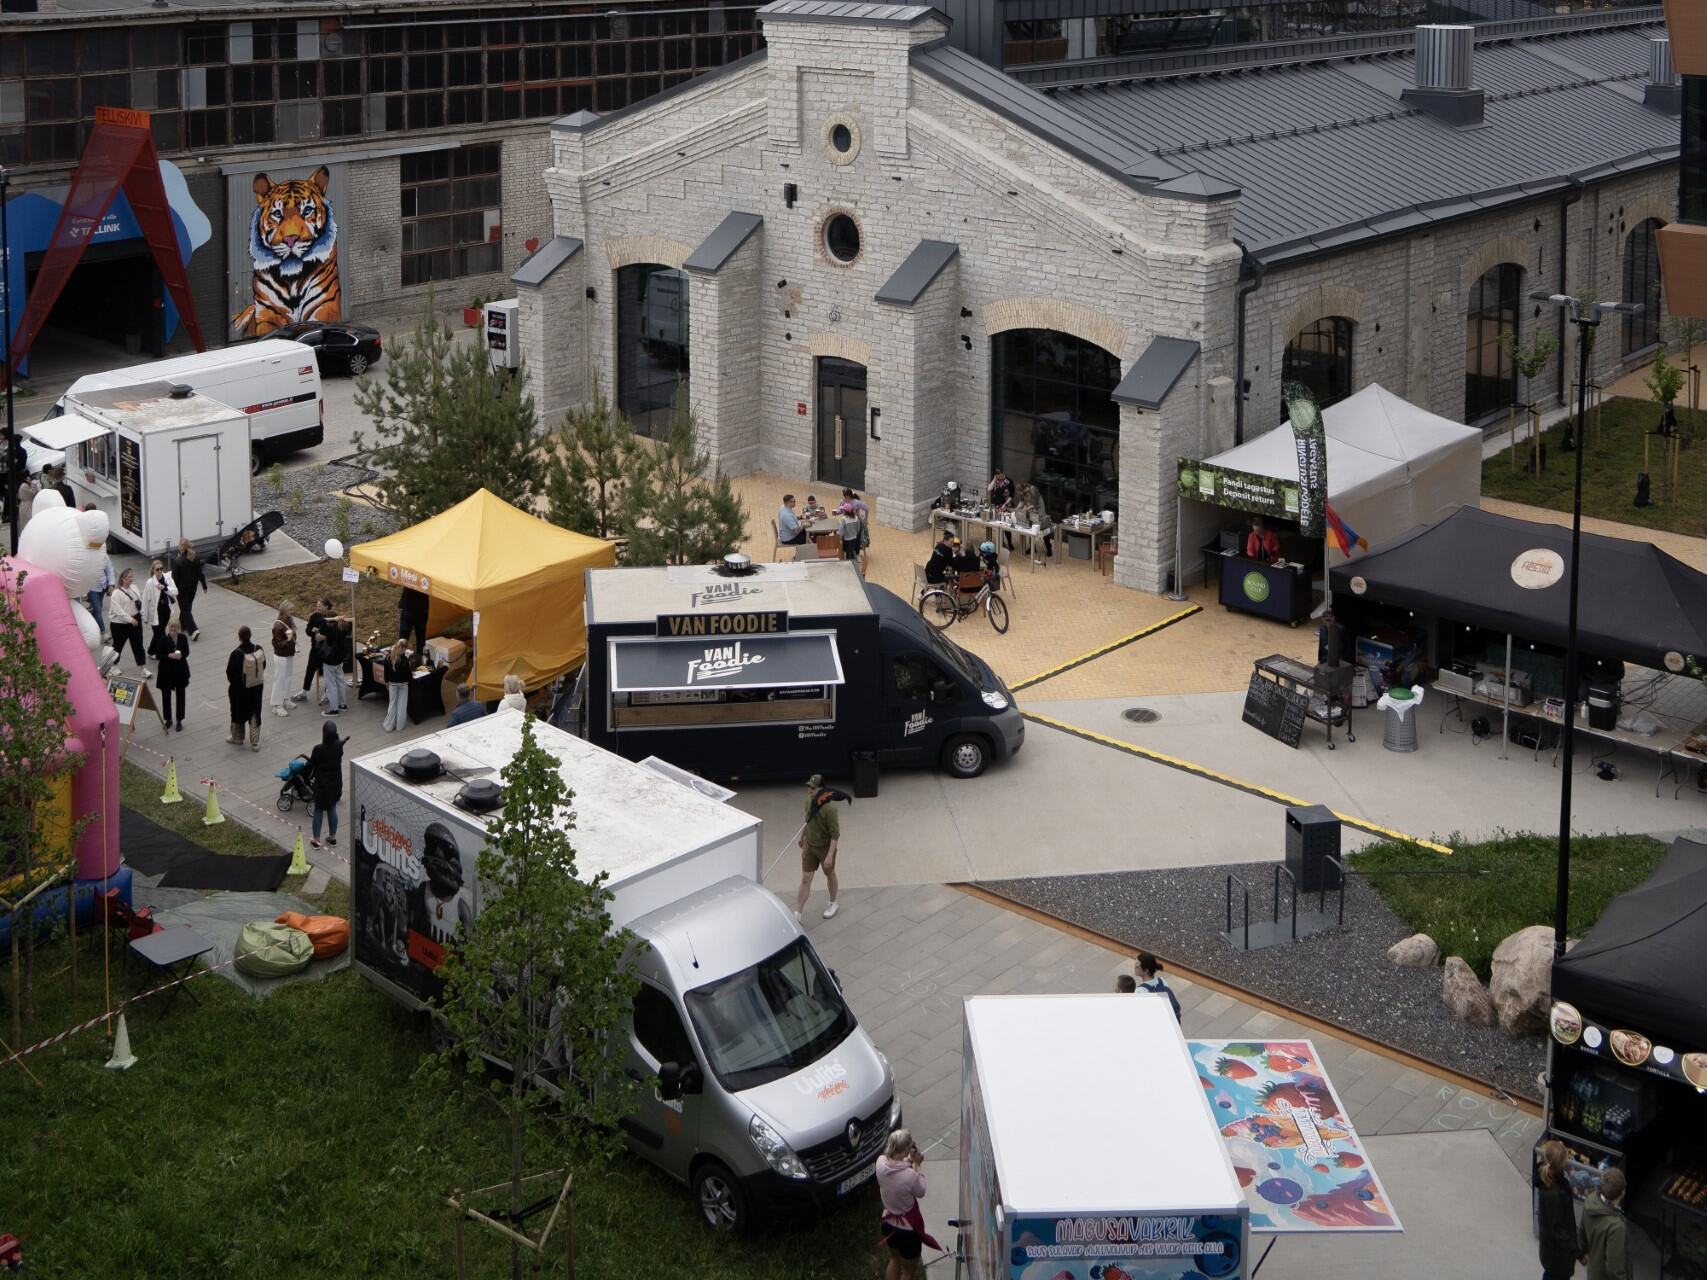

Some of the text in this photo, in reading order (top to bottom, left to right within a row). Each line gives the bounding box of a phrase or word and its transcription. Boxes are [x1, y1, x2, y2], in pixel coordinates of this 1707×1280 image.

[97, 108, 142, 127] TELLISKIVI
[81, 223, 120, 236] TLINK
[1223, 477, 1275, 495] Pandi tagastus
[1223, 488, 1275, 505] Deposit return
[691, 582, 763, 608] Foodie
[705, 583, 732, 594] VAN
[669, 613, 777, 636] VAN FOODIE
[687, 641, 766, 684] Foodie
[704, 647, 733, 662] VAN
[1056, 1216, 1196, 1244] MAGUSAVABRIK
